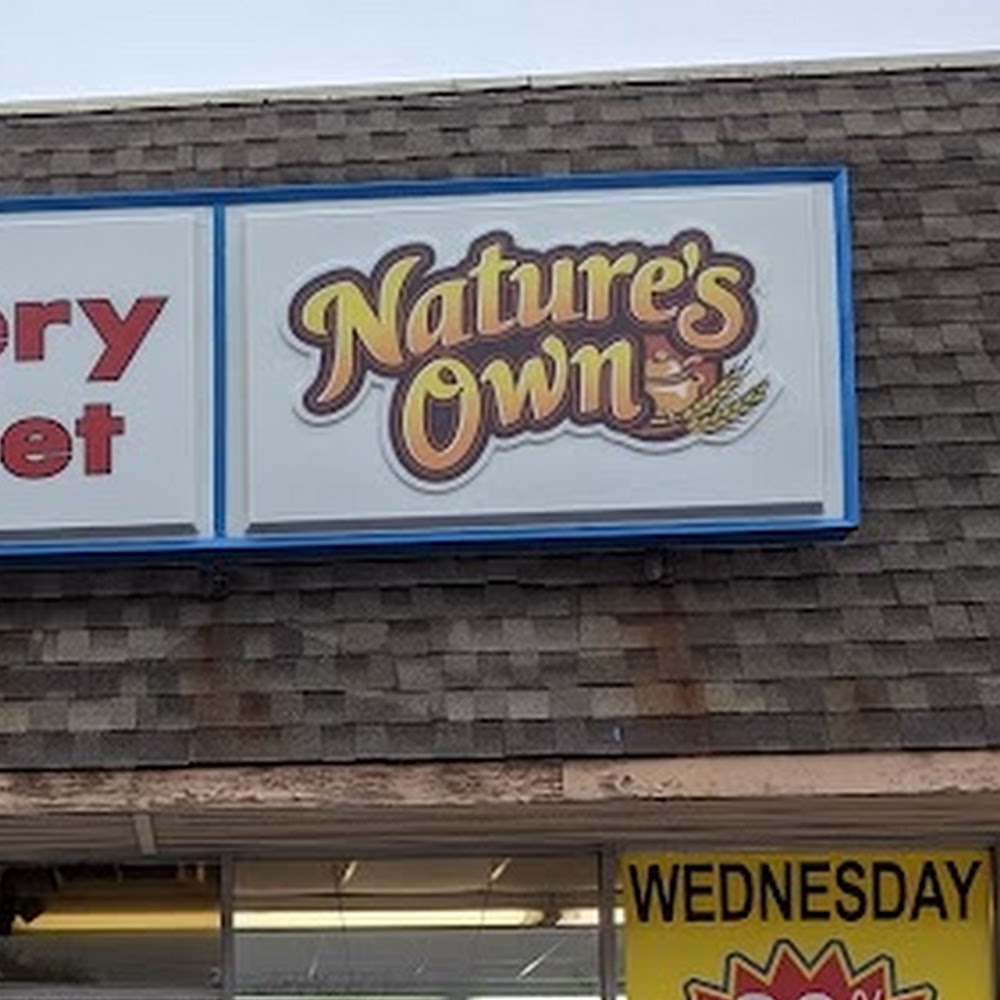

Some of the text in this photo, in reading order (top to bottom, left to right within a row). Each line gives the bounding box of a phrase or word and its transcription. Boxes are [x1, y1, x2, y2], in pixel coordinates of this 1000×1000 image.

[297, 235, 749, 408] Nature's
[398, 332, 647, 475] Own
[629, 860, 982, 923] WEDNESDAY
